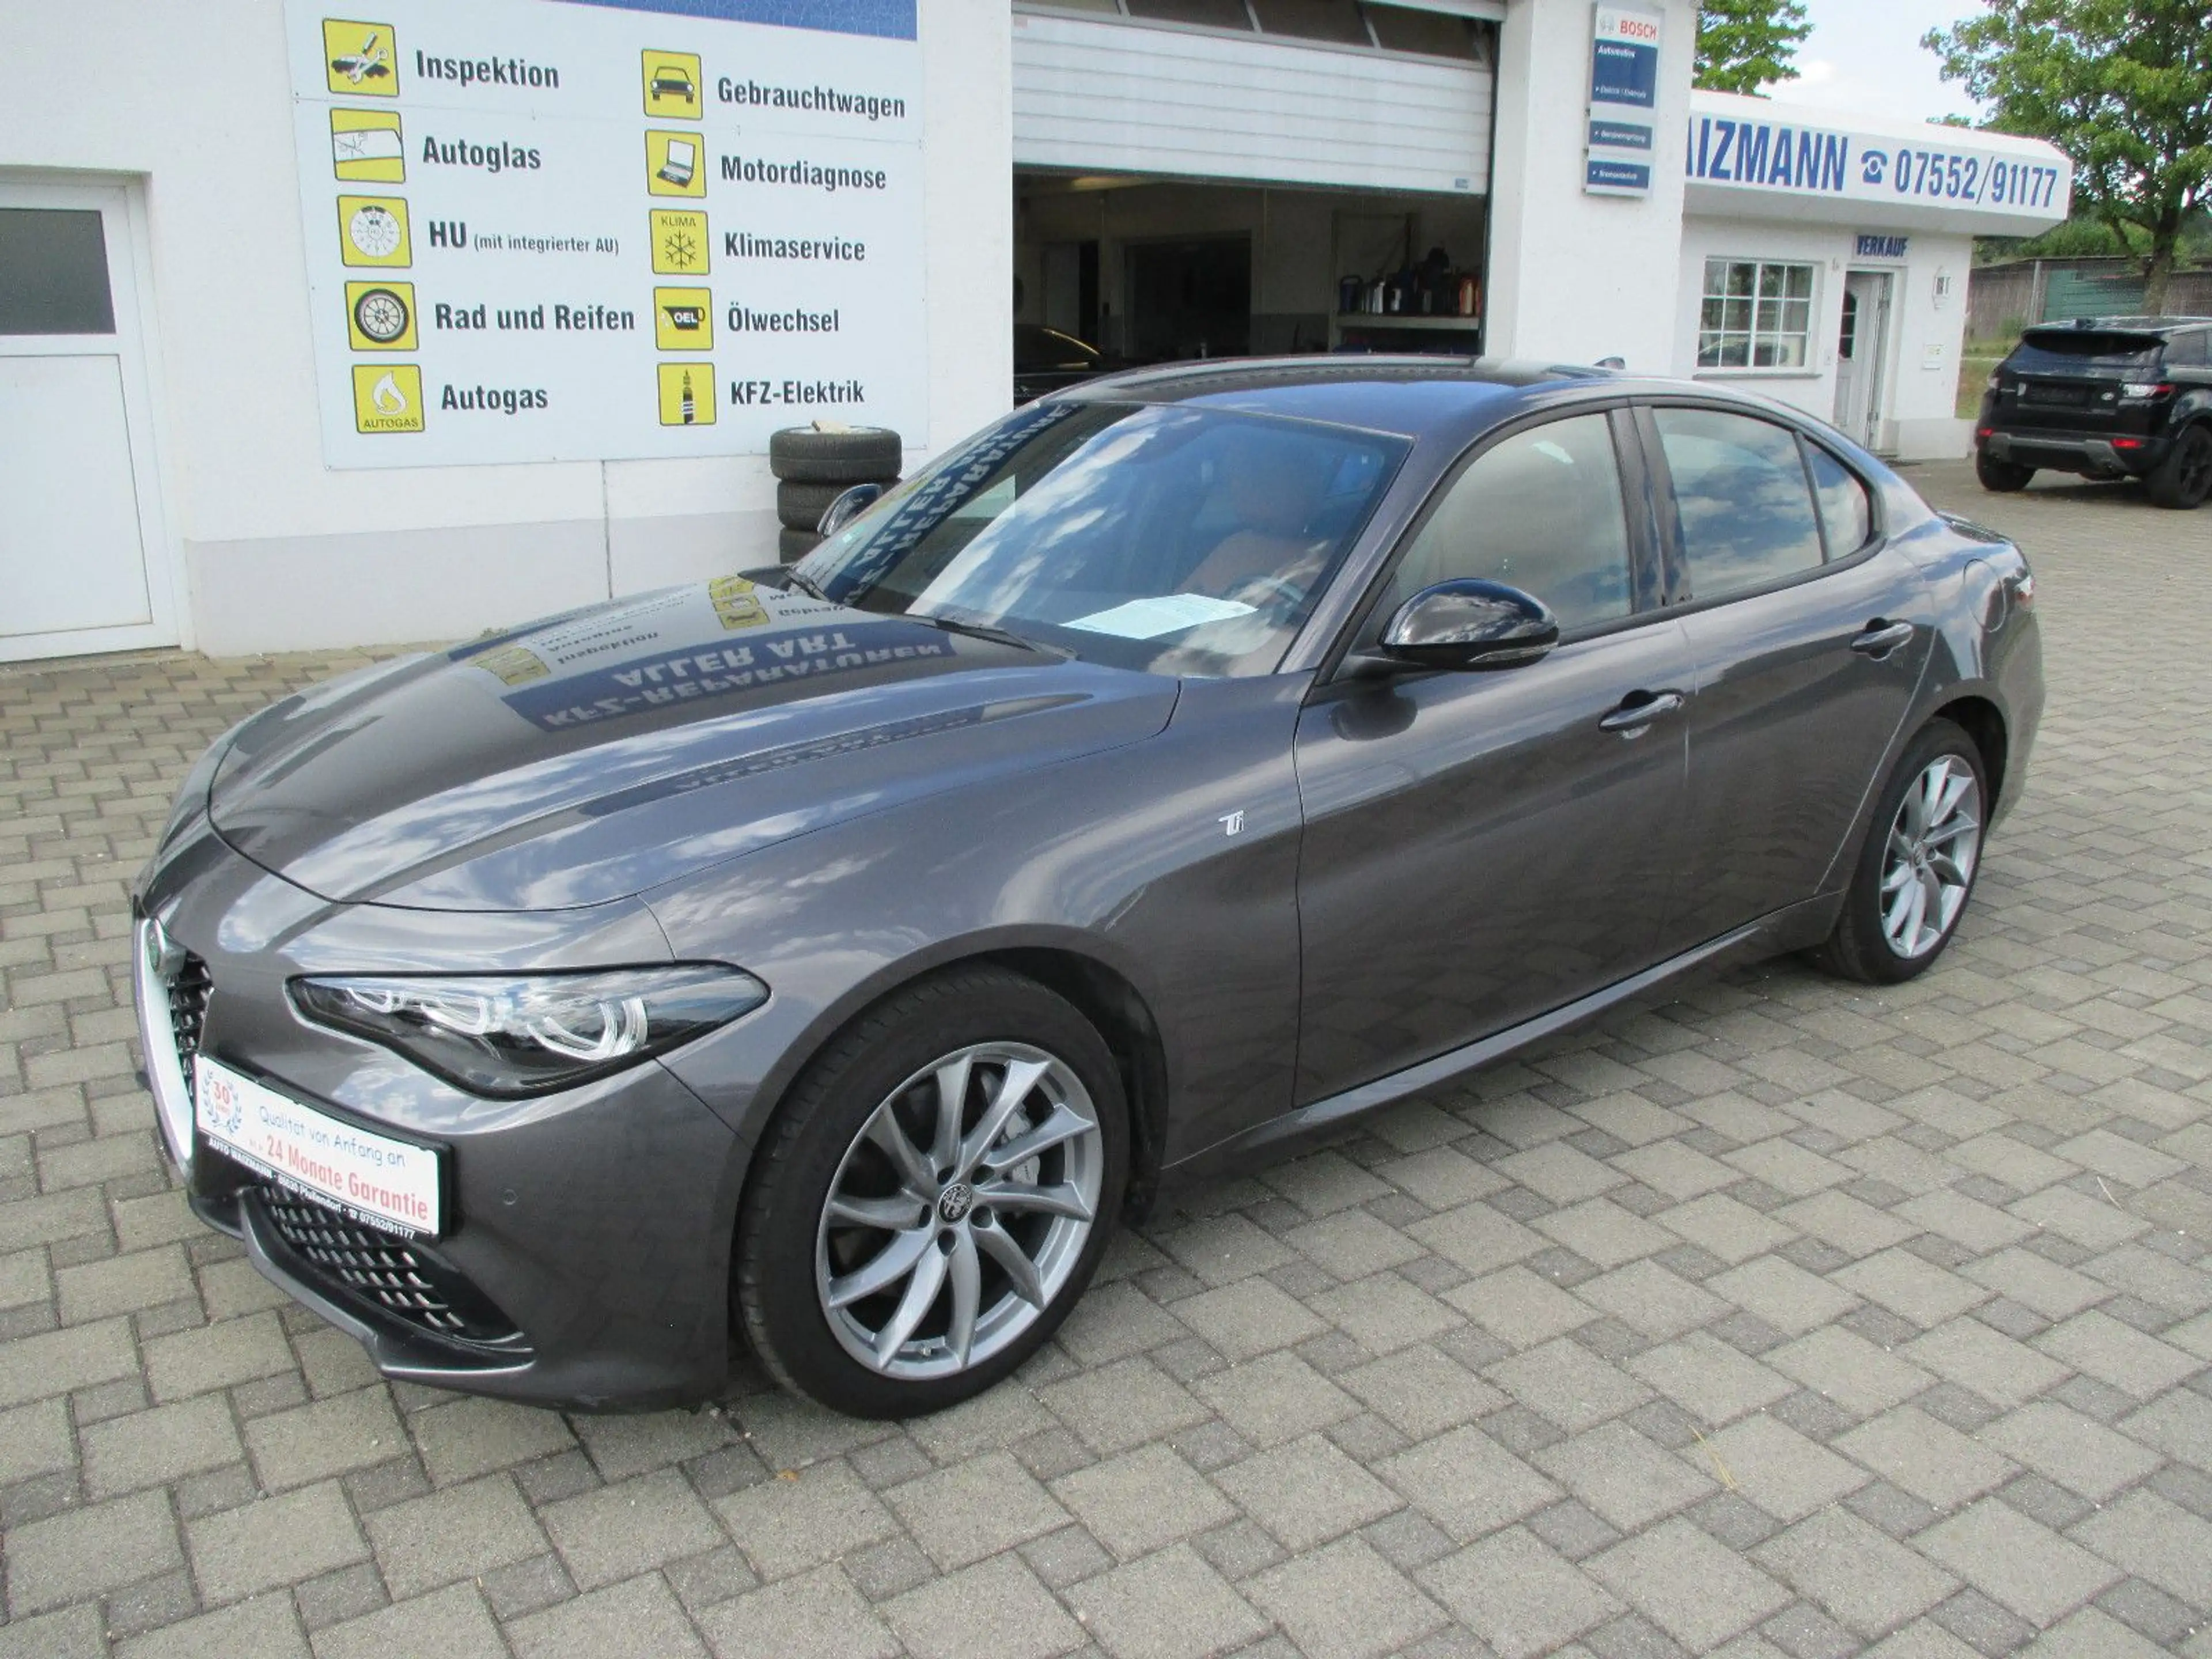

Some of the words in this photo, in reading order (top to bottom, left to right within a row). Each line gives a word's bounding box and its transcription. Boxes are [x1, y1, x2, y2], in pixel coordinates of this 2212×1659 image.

[1620, 20, 1657, 40] BOSCH
[416, 50, 559, 88] Inspektion
[718, 77, 906, 121] Gebrauchtwagen
[423, 136, 541, 174] Autoglas
[721, 155, 887, 191] Motordiagnose
[1895, 149, 2057, 208] 07552/91177
[661, 216, 696, 228] KLIMA
[429, 221, 467, 249] HU
[474, 233, 503, 253] (mit
[508, 234, 590, 255] integrierter
[596, 239, 620, 256] AU)
[725, 232, 866, 261] Klimaservice
[1857, 235, 1909, 257] VERKAUF
[435, 304, 487, 331] Rad
[498, 305, 543, 330] und
[555, 305, 635, 331] Reifen
[674, 311, 698, 323] OEL
[728, 302, 840, 333] Ölwechsel
[442, 384, 549, 415] Autogas
[730, 380, 865, 405] KFZ-Elektrik
[363, 417, 419, 429] AUTOGAS
[213, 1081, 230, 1104] 30
[309, 1128, 330, 1147] von
[335, 1137, 383, 1168] Anfang
[388, 1152, 406, 1168] an
[267, 1135, 283, 1162] 24
[289, 1149, 343, 1190] Monate
[349, 1175, 429, 1221] Garantie
